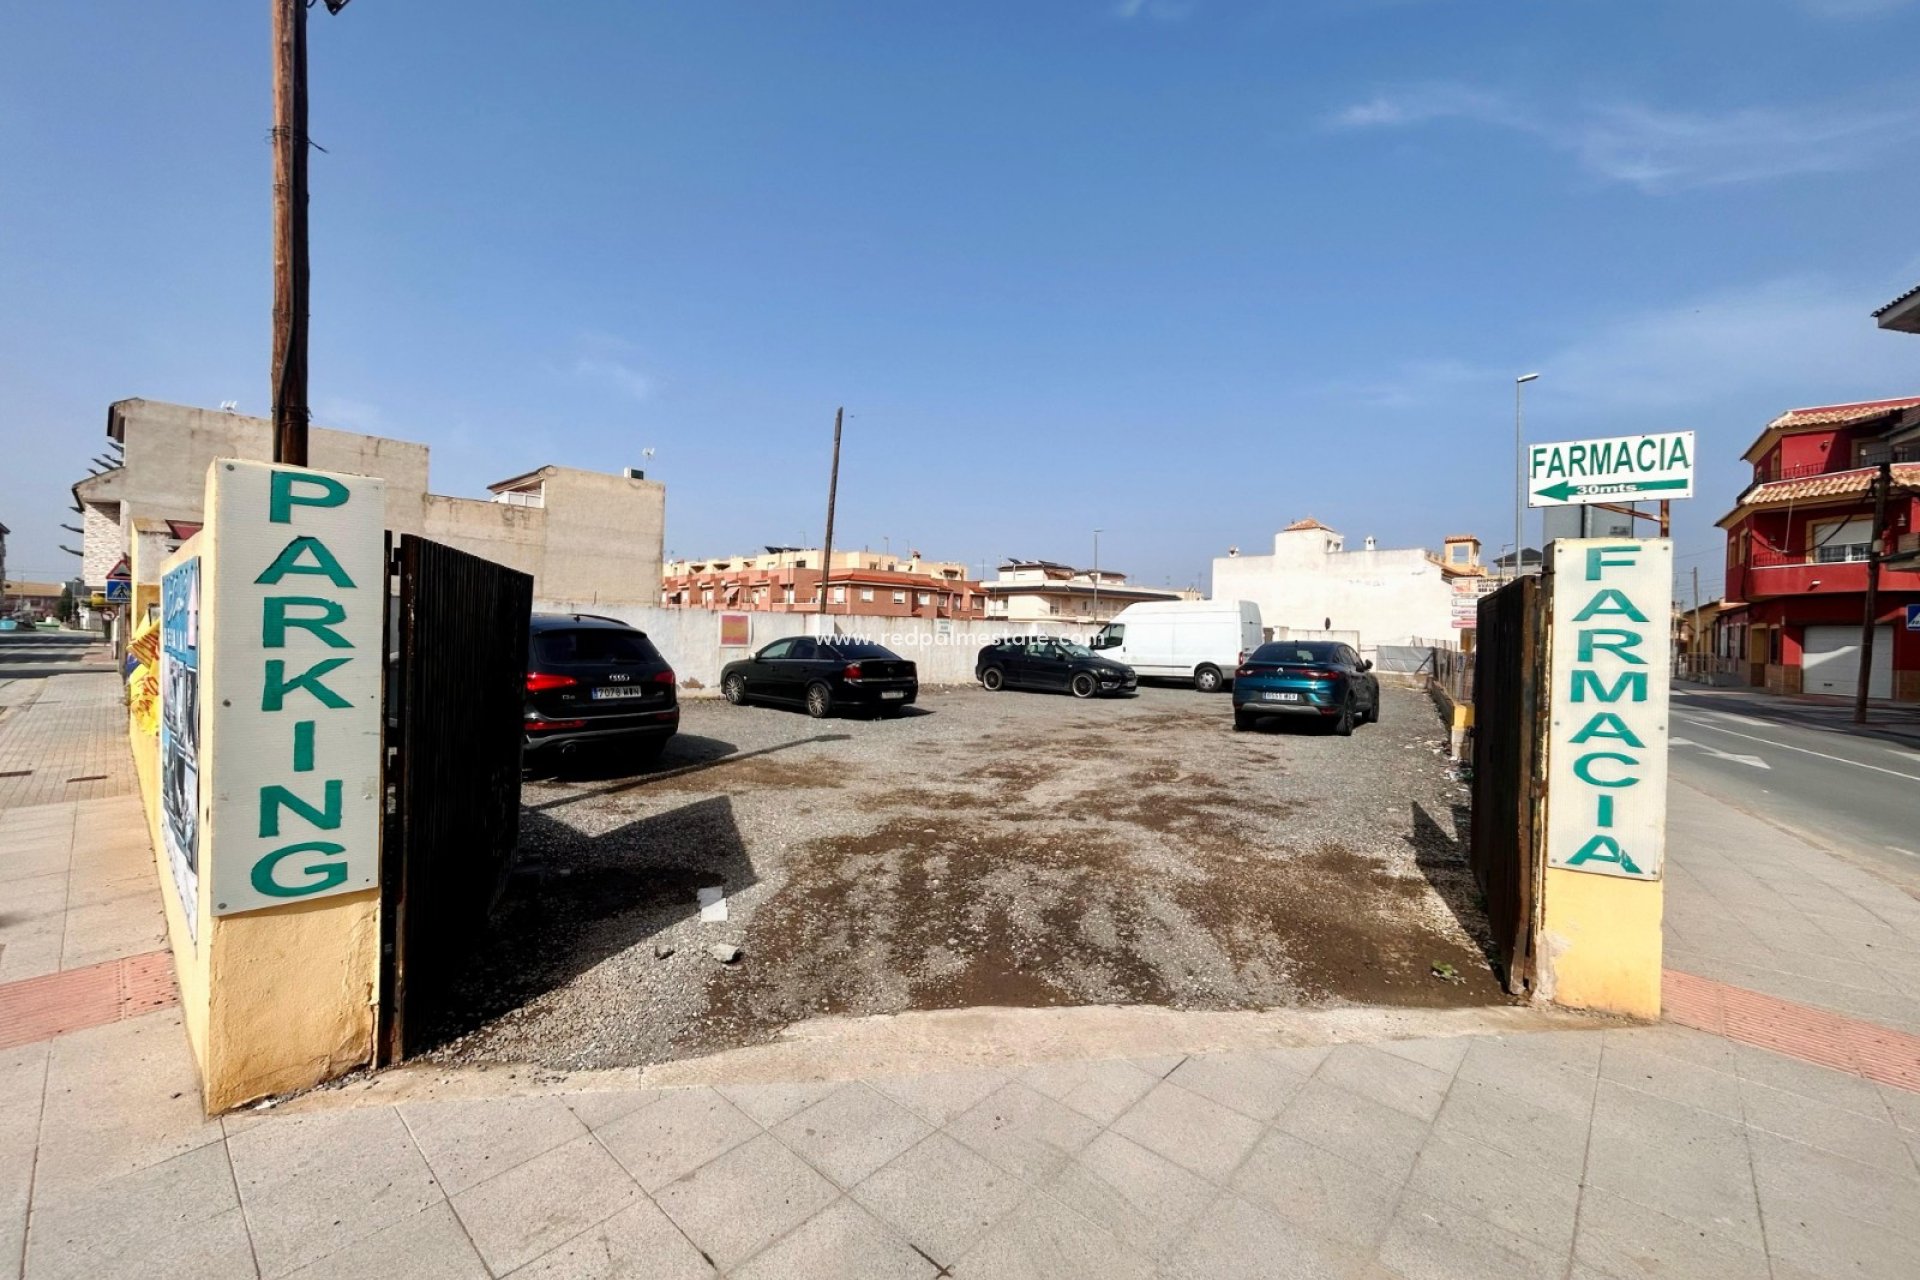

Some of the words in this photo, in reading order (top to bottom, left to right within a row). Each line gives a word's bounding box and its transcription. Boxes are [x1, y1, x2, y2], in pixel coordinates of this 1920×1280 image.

[1533, 437, 1690, 479] FARMACIA
[251, 469, 357, 898] PARKING
[1565, 545, 1650, 875] FARMACIA
